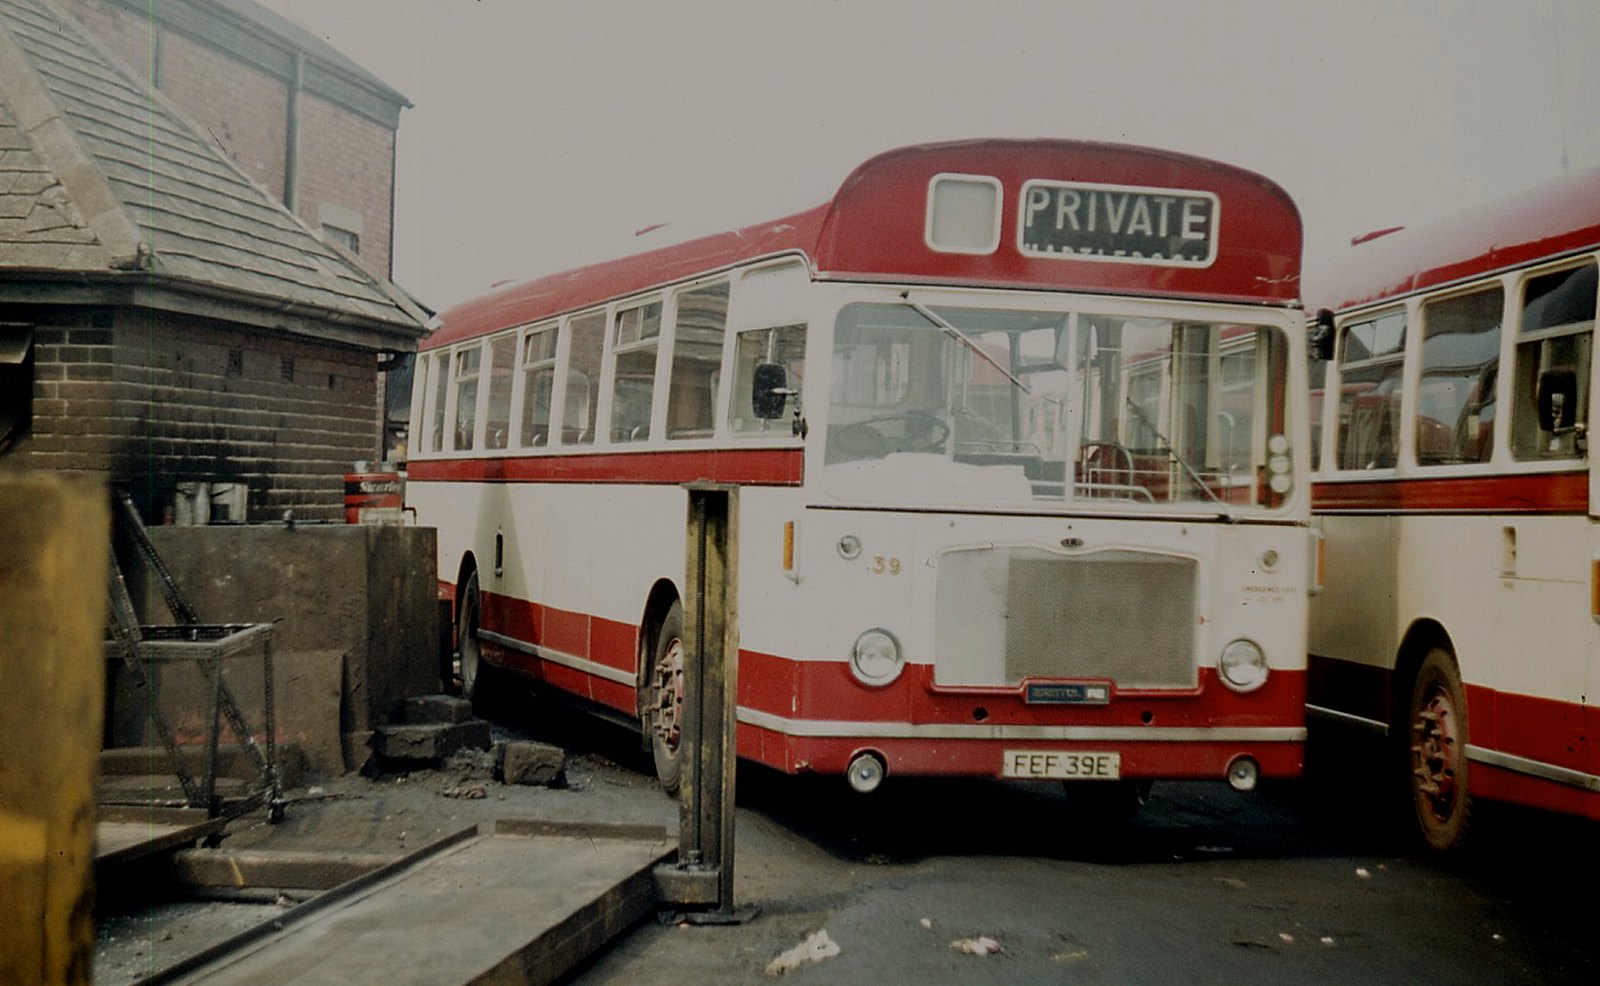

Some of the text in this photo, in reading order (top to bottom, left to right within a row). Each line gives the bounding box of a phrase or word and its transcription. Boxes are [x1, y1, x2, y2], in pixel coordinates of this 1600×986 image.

[1025, 187, 1208, 240] PRIVATE
[872, 556, 901, 576] 39
[1014, 754, 1110, 776] FEF 39E
